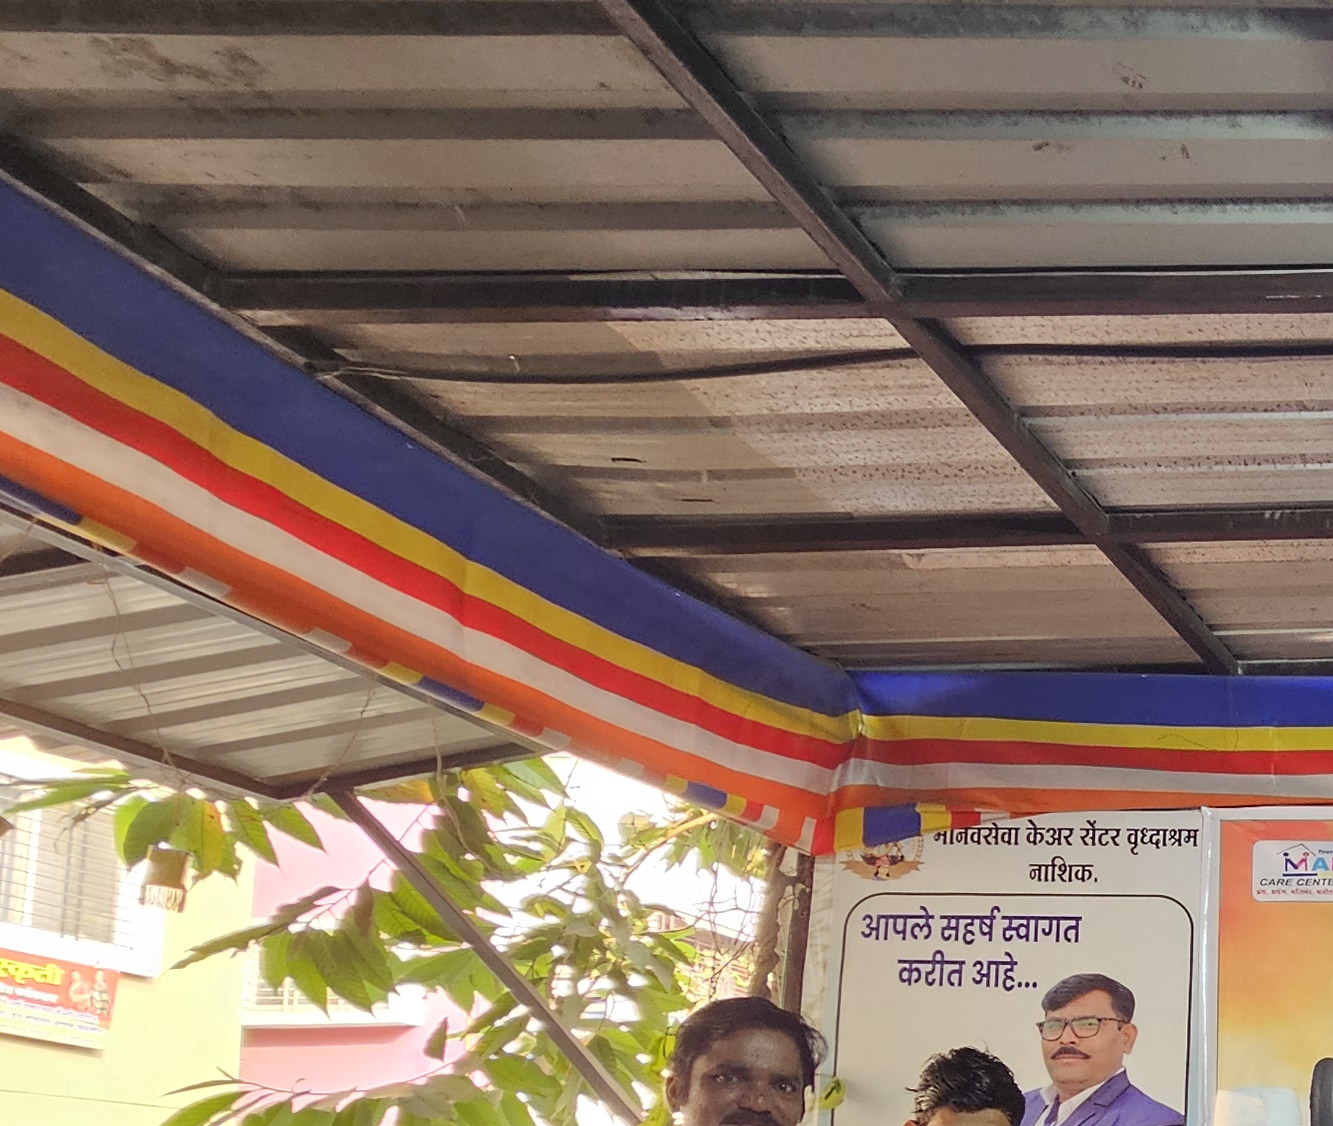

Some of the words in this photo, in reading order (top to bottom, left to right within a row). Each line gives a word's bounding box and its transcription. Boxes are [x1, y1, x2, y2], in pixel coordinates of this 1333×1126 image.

[1026, 819, 1074, 847] केअर
[1080, 819, 1121, 847] सेंटर
[1029, 855, 1098, 883] नाशिक.
[1259, 878, 1293, 887] CARE
[861, 906, 934, 945] आपले
[939, 905, 1001, 945] सहर्ष
[1001, 915, 1083, 944] स्वागत
[897, 949, 966, 990] करीत
[971, 951, 1038, 991] आहे...
